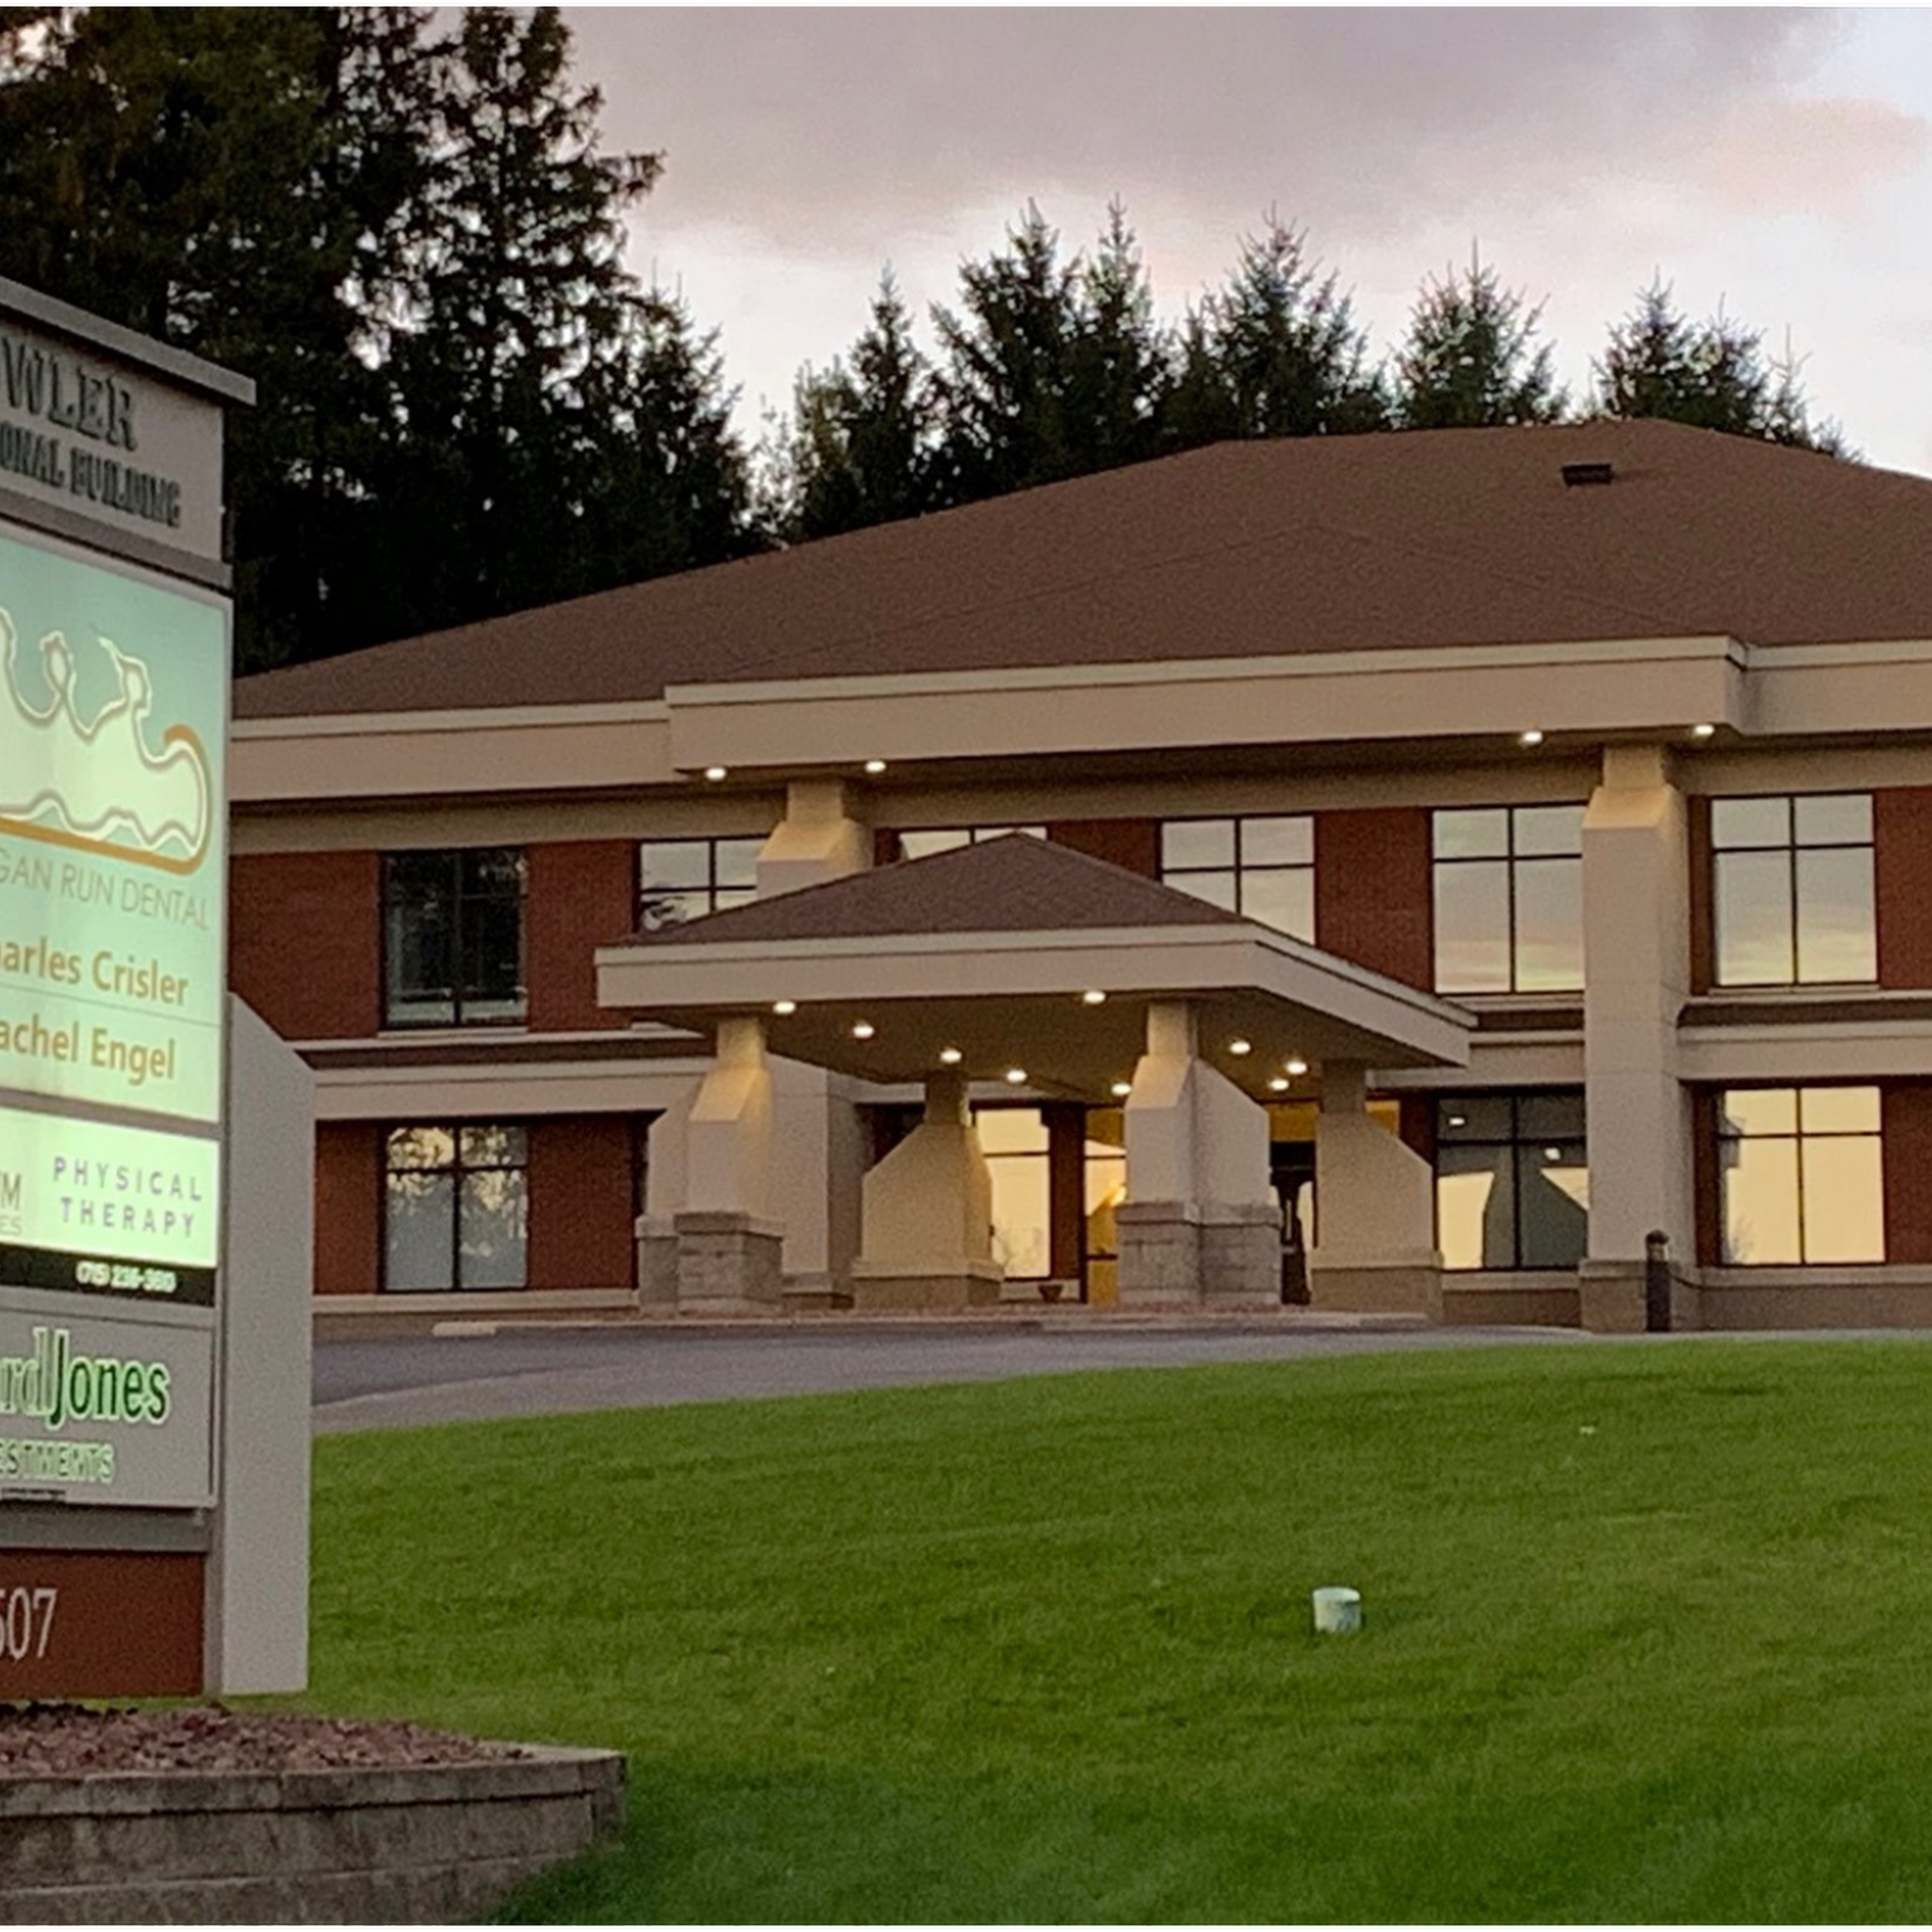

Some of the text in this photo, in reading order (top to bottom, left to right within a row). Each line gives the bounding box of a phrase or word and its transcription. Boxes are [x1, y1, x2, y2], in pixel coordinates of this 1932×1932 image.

[71, 445, 181, 528] BUILDING
[60, 863, 115, 904] RUN
[120, 877, 209, 931] DENTAL
[0, 935, 189, 1006] arles Crisler
[91, 1026, 176, 1086] Engel
[53, 1156, 202, 1202] PHYSICAL
[60, 1197, 195, 1238] THERAPY
